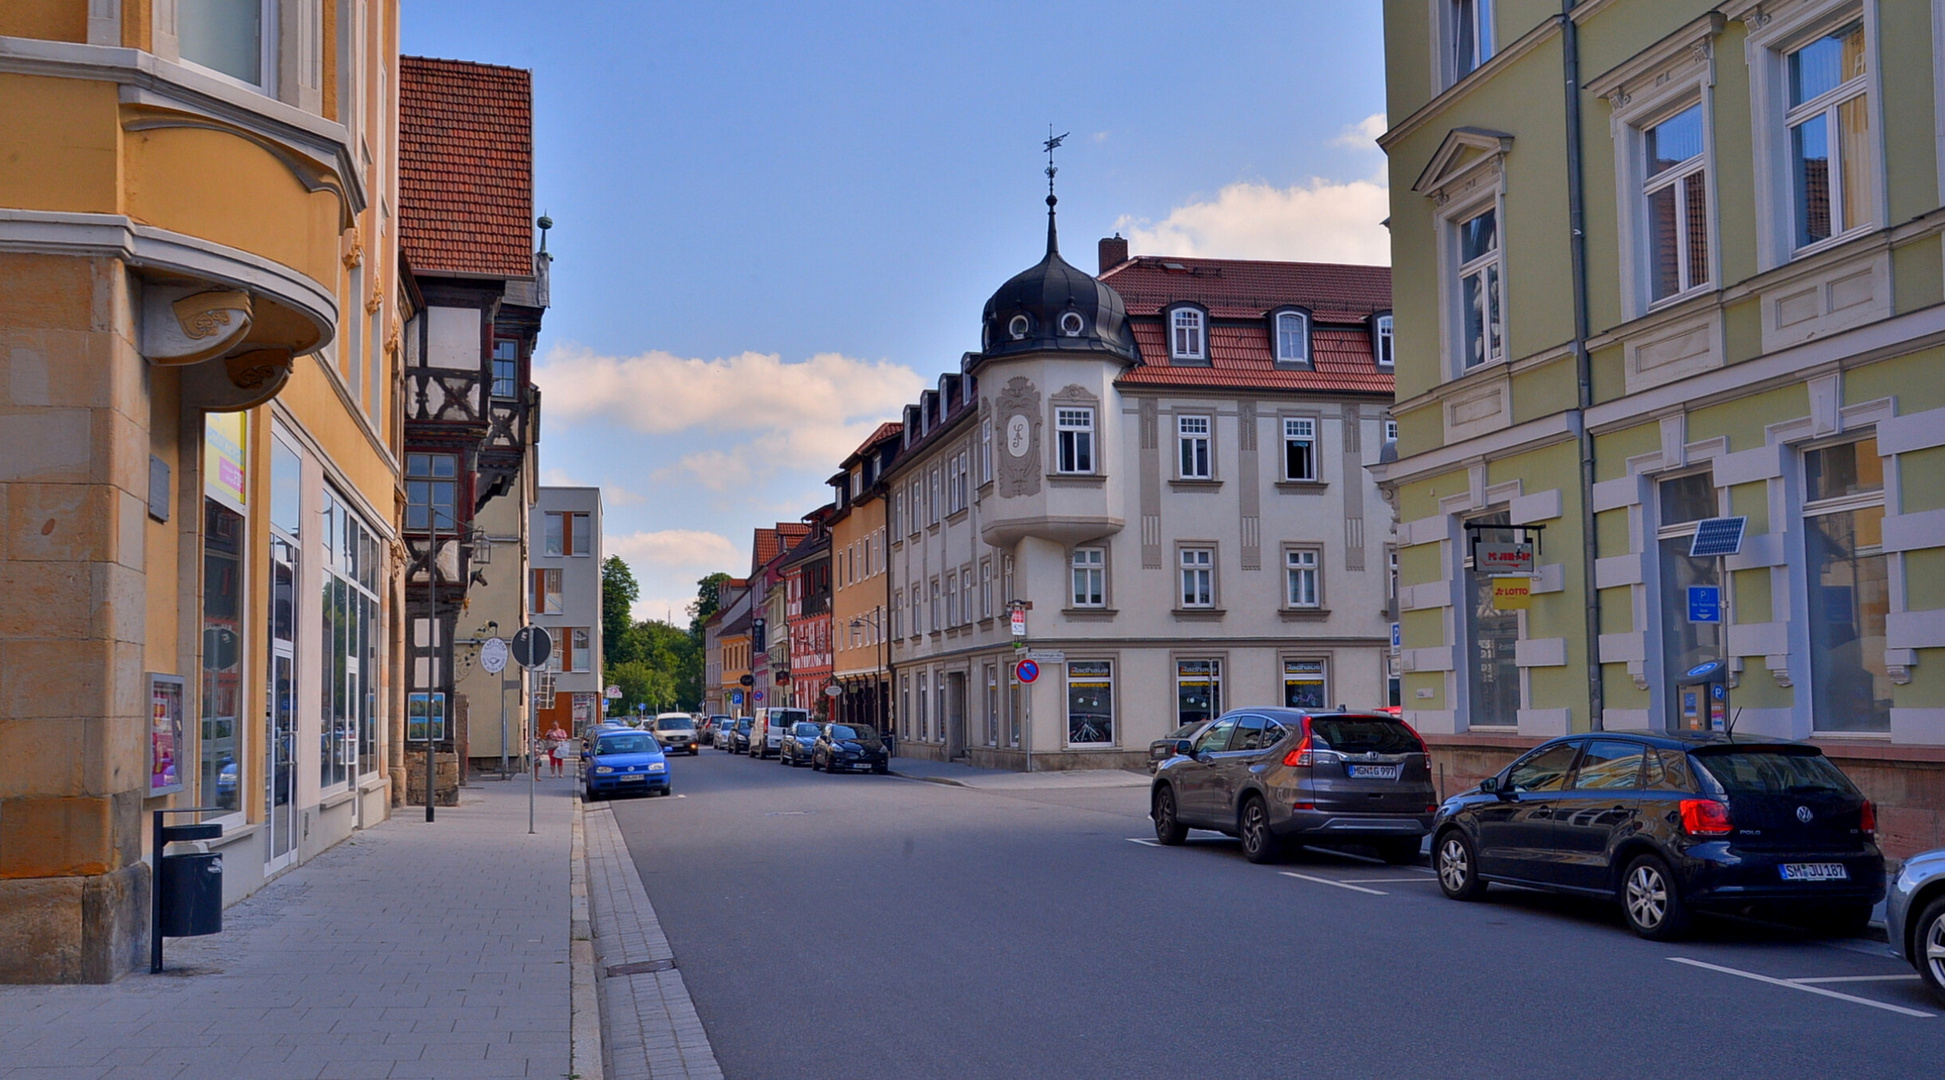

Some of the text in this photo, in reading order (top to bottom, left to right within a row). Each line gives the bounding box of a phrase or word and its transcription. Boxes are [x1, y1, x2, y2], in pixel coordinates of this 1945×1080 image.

[1505, 587, 1529, 596] LOTTO
[1700, 590, 1707, 599] P
[1394, 627, 1400, 643] P
[1715, 687, 1722, 698] P
[734, 694, 741, 703] P
[1354, 766, 1395, 776] MGN G 997
[1786, 864, 1843, 878] SM JU 187
